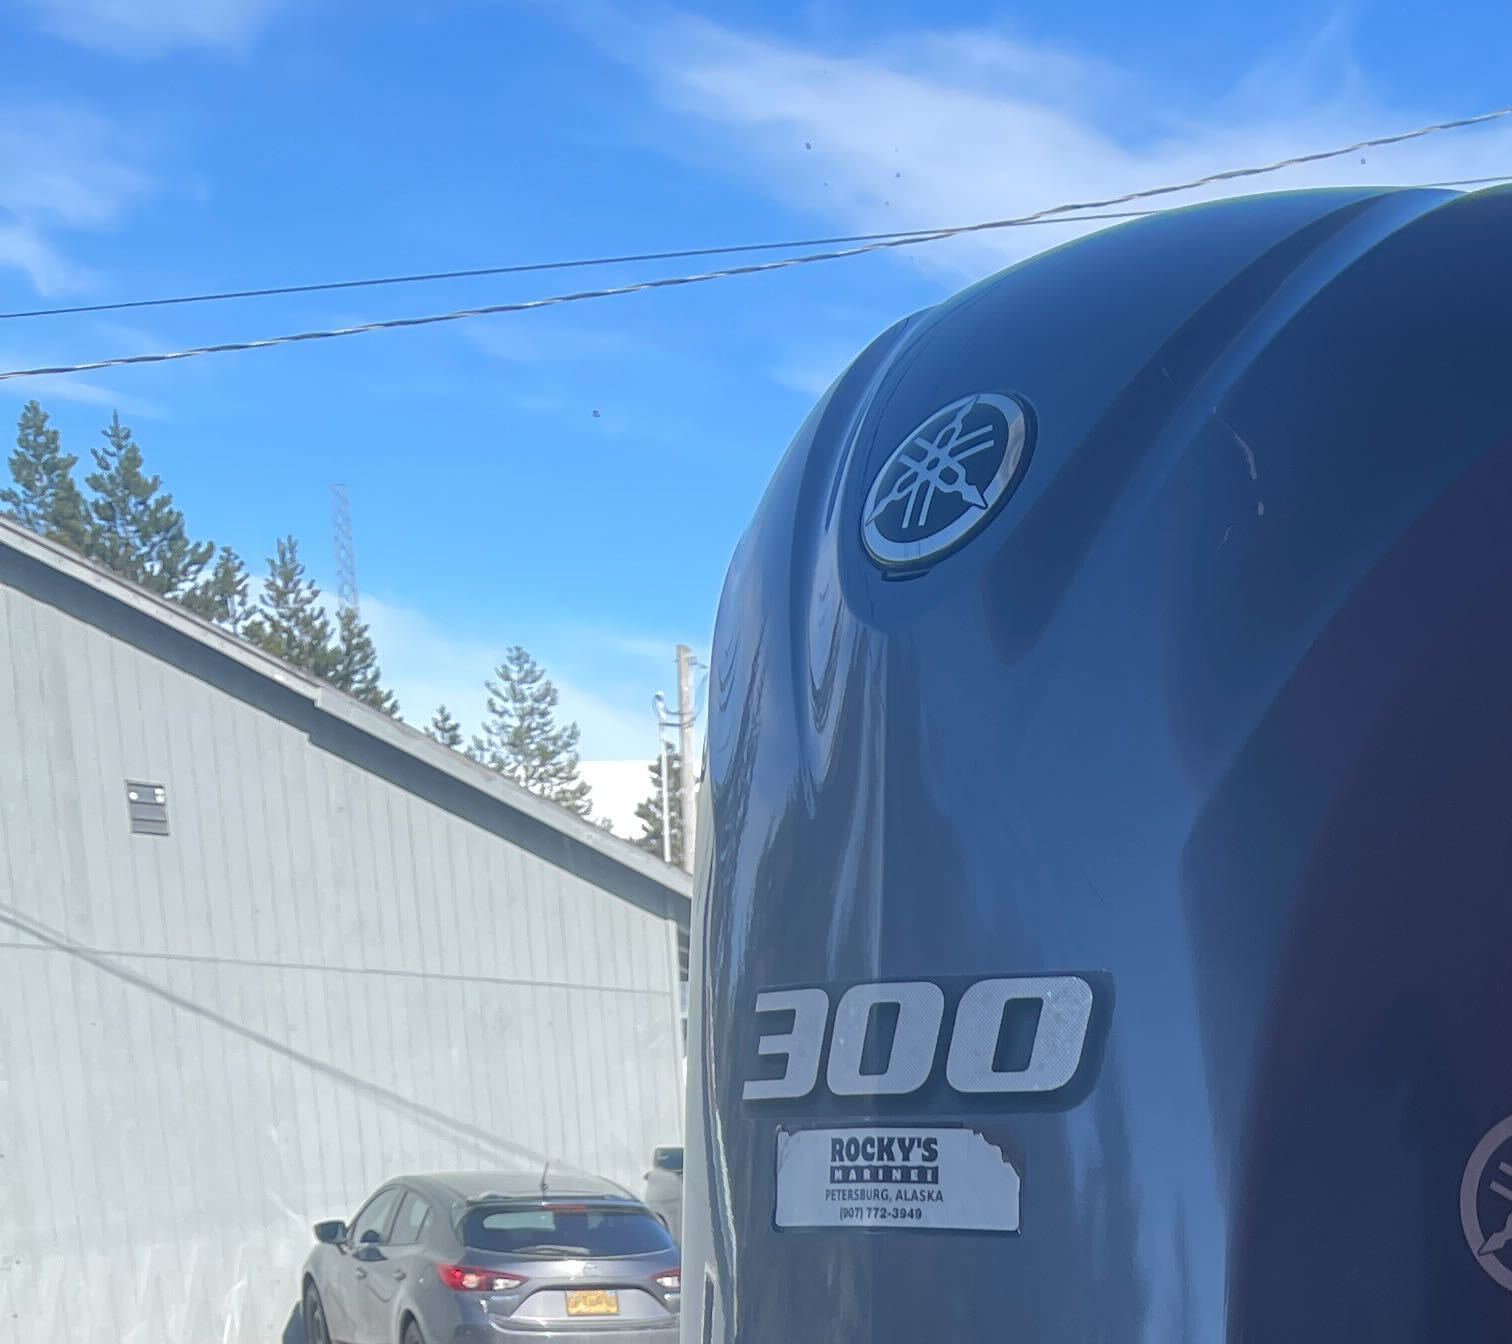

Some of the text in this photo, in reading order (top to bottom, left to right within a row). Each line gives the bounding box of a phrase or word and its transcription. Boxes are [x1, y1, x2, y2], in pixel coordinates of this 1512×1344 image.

[742, 976, 1093, 1100] 300
[830, 1136, 938, 1162] ROCKY'S
[825, 1188, 944, 1203] PETERSBURG, ALASKA
